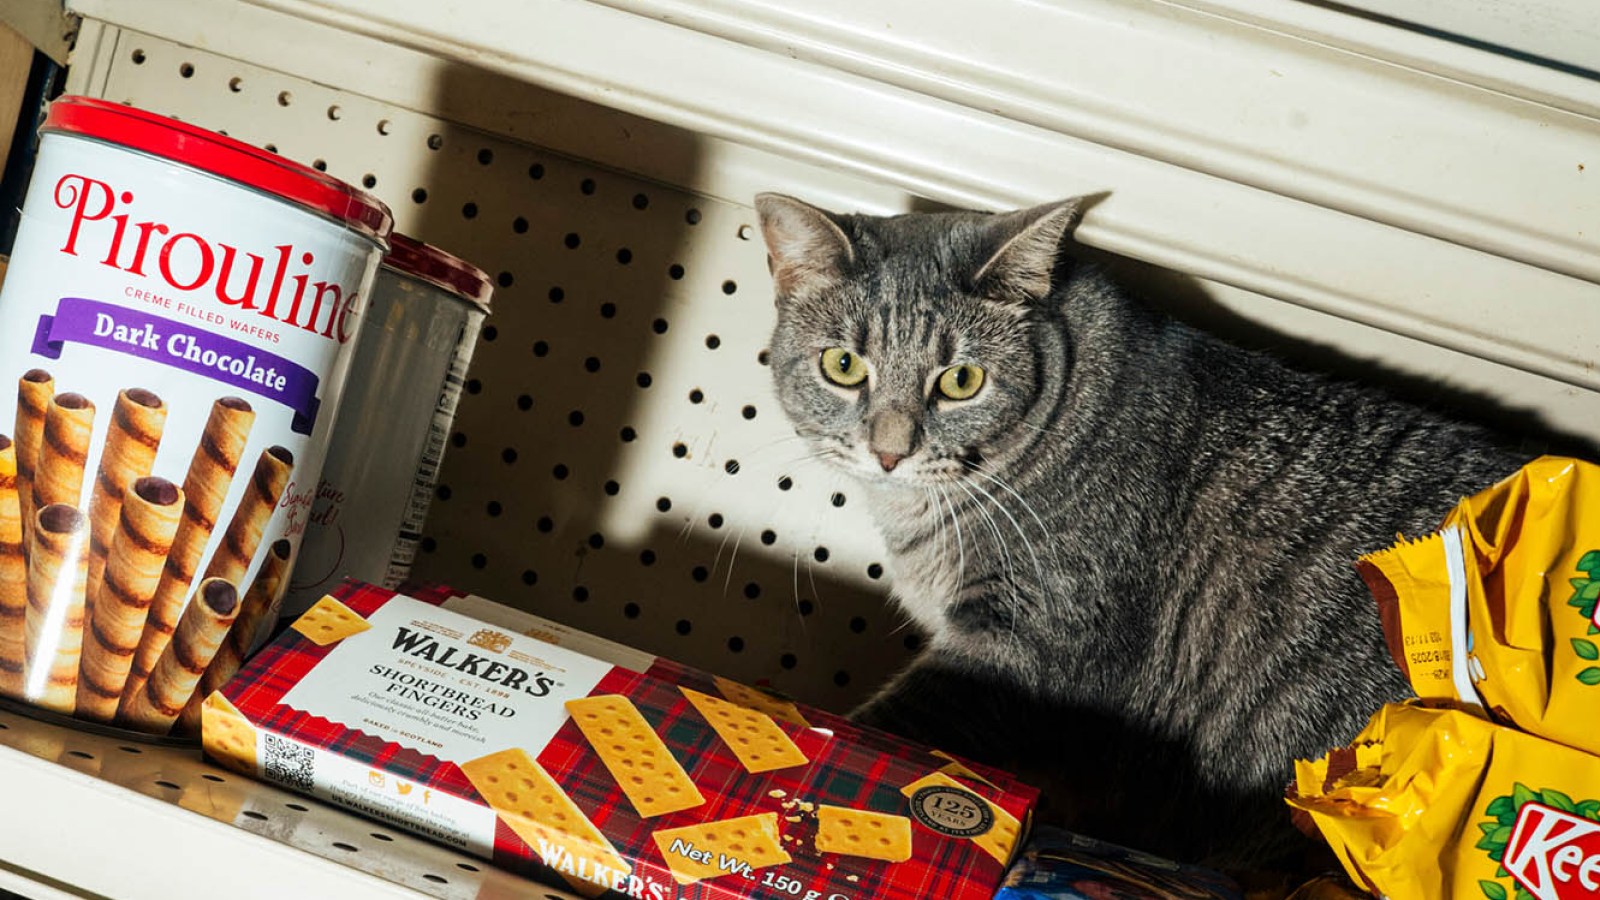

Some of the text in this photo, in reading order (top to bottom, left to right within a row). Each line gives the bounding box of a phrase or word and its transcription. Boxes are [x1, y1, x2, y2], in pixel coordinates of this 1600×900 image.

[54, 173, 358, 344] Pirouline
[177, 302, 225, 325] FILLED
[230, 319, 281, 344] WAFERS
[93, 313, 287, 392] Dark Chocolate
[368, 692, 386, 700] Our
[369, 664, 516, 718] SHORTBREAD
[398, 659, 447, 677] SPEYSIDE
[486, 688, 510, 699] 1898
[351, 695, 394, 713] deliciously
[397, 710, 434, 726] crumbly
[433, 723, 452, 731] and
[386, 683, 481, 721] FINGERS
[363, 718, 390, 730] BAKED
[400, 731, 444, 749] SCOTLAND
[425, 818, 438, 827] the
[931, 796, 976, 819] 125
[931, 810, 966, 827] YEARS
[537, 838, 664, 900] WALKER'S
[669, 837, 713, 866] Net
[719, 853, 757, 881] Wt.
[761, 871, 802, 895] 150
